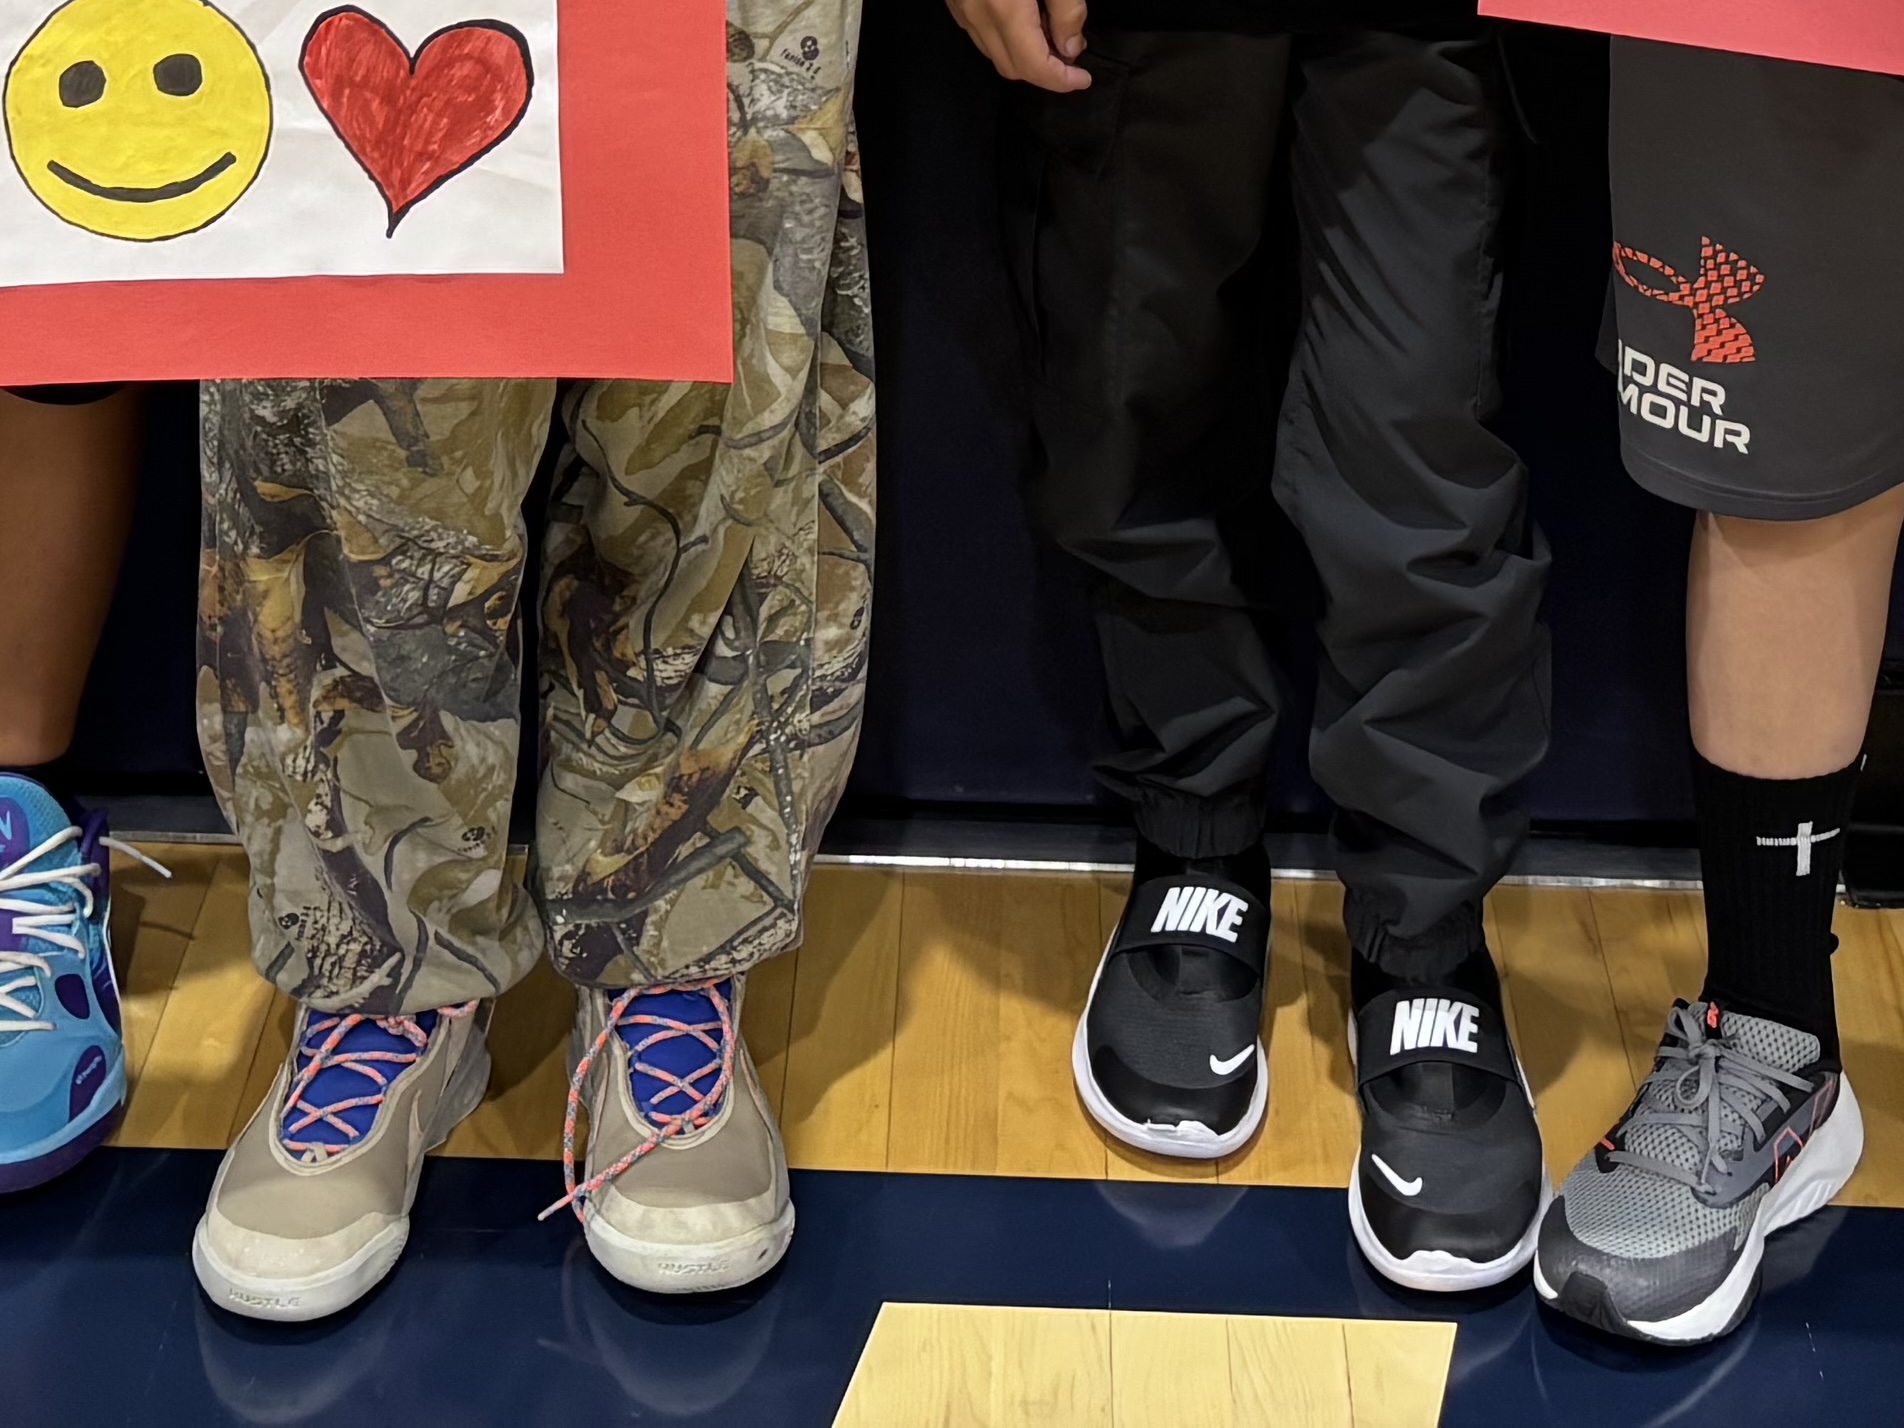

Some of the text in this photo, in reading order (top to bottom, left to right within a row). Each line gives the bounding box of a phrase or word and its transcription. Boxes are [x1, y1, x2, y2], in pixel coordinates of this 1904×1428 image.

[1617, 339, 1727, 416] DER
[1150, 886, 1249, 943] NIKE
[1389, 997, 1480, 1056] NIKE
